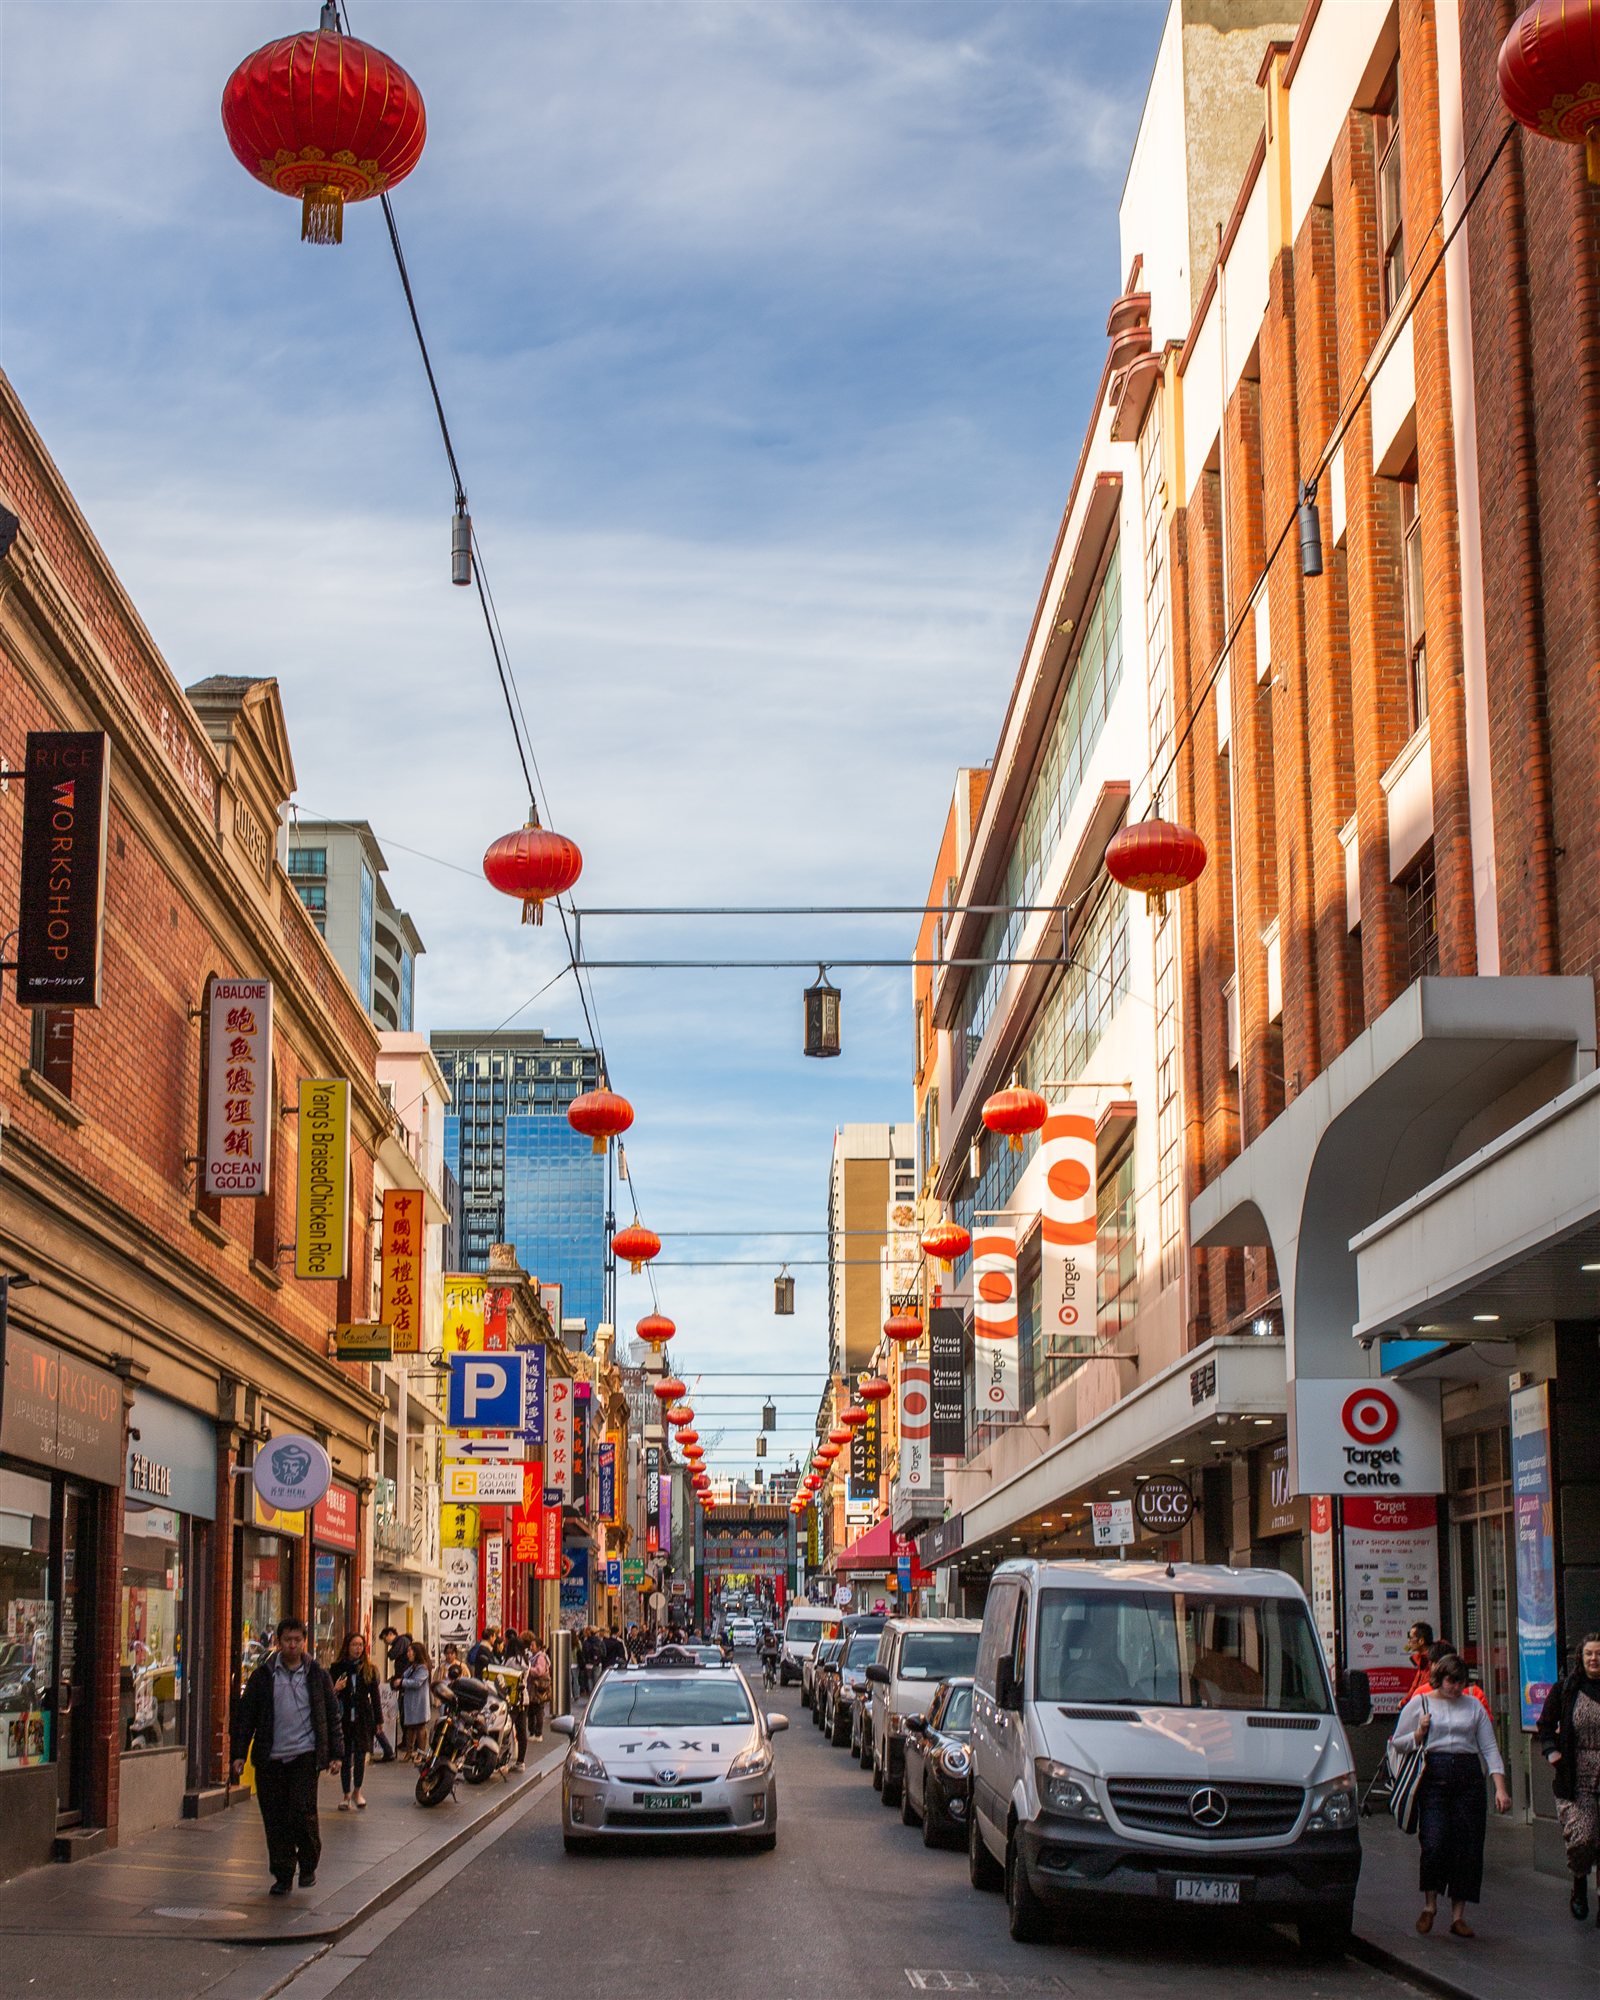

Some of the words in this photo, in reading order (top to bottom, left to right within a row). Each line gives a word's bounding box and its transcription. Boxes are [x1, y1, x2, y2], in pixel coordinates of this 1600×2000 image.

[214, 985, 266, 1000] ABALONE
[306, 1085, 337, 1129] Yang's
[211, 1162, 262, 1176] OCEAN
[215, 1175, 256, 1190] GOLD
[308, 1243, 333, 1273] Rice
[1062, 1257, 1080, 1304] Target
[933, 1336, 960, 1345] VINTAGE
[933, 1345, 961, 1353] CELLARS
[933, 1369, 961, 1378] VINTAGE
[991, 1349, 1005, 1385] Target
[933, 1378, 961, 1387] CELLARS
[463, 1362, 507, 1419] P
[934, 1402, 962, 1411] VINTAGE
[933, 1411, 961, 1420] CELLARS
[909, 1445, 920, 1472] Target
[1342, 1446, 1401, 1467] Target
[1518, 1455, 1546, 1473] International
[148, 1462, 171, 1496] HERE
[479, 1472, 518, 1481] GOLDEN
[1342, 1470, 1401, 1486] Centre
[1518, 1473, 1541, 1491] graduates
[479, 1481, 516, 1489] SQUARE
[650, 1472, 659, 1515] BORNGA
[1141, 1494, 1188, 1513] UGG
[1374, 1500, 1407, 1514] Target
[1519, 1495, 1539, 1513] Launch
[1374, 1514, 1408, 1524] Centre
[1519, 1513, 1531, 1529] your
[1098, 1526, 1111, 1538] 1P
[516, 1552, 539, 1560] GIFTS
[609, 1563, 618, 1574] P
[618, 1740, 720, 1754] TAXI
